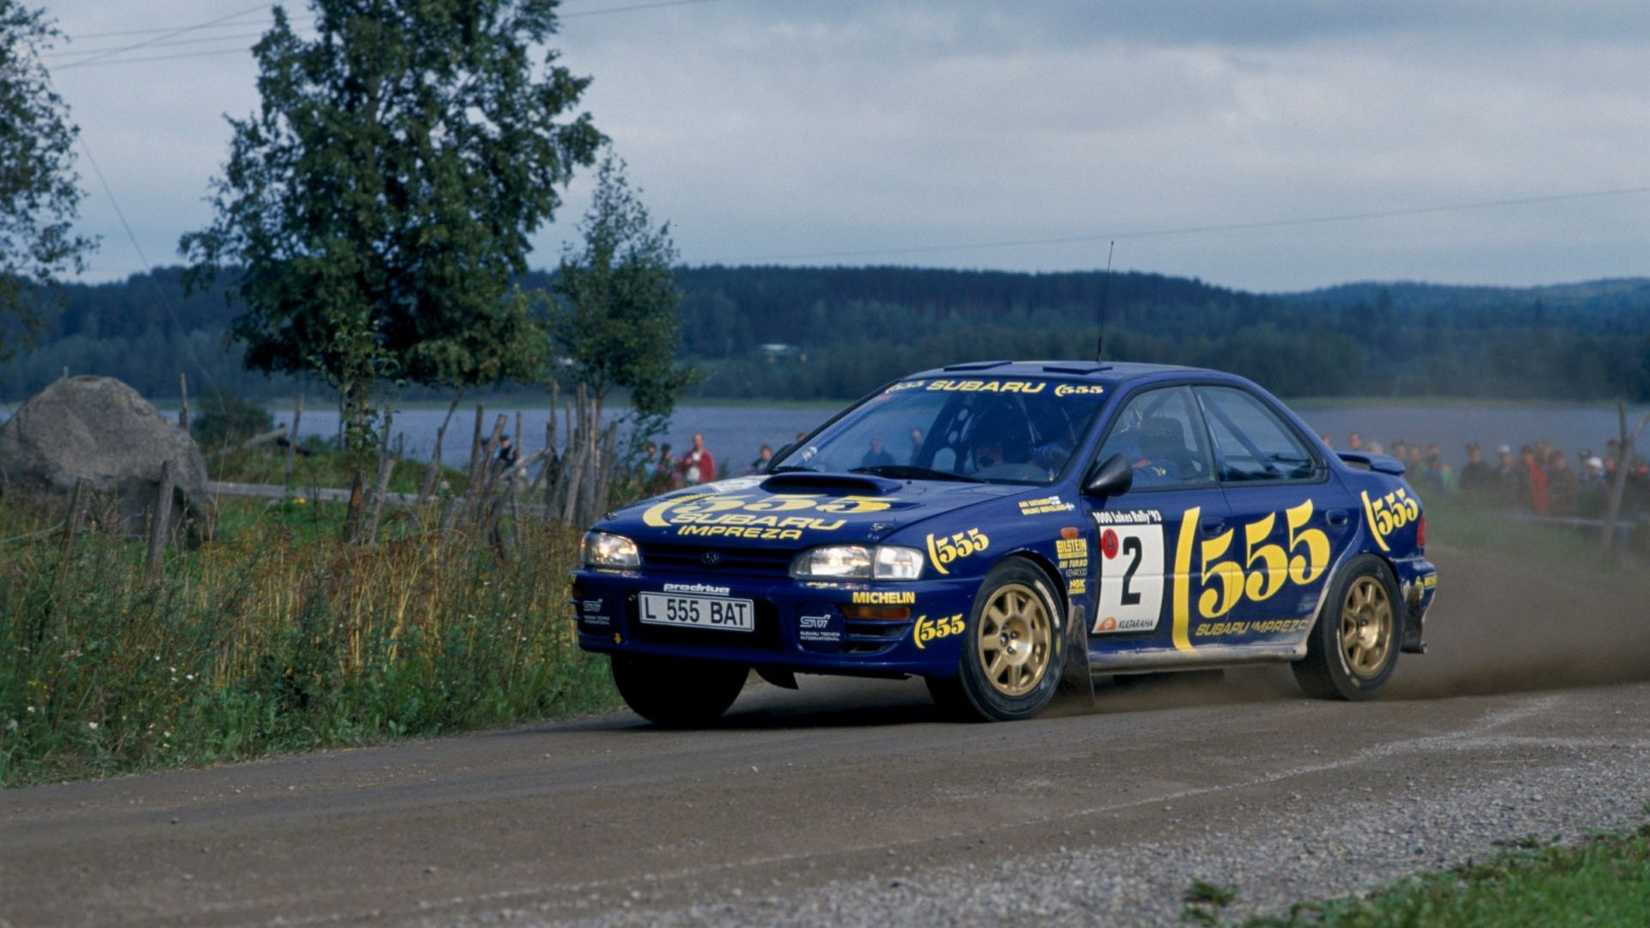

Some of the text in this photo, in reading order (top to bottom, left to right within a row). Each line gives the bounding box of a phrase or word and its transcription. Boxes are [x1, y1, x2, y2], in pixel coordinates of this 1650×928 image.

[926, 380, 1046, 393] SUBARU
[1061, 385, 1103, 394] 555
[670, 513, 847, 530] SUBARU
[1373, 488, 1418, 535] 555
[677, 525, 803, 540] IMPREZA
[936, 528, 989, 563] 555
[1121, 536, 1142, 605] 2
[1198, 499, 1330, 618] 555
[645, 597, 747, 626] L 555 BAT
[853, 592, 915, 604] MICHELIN
[921, 613, 966, 641] 555
[1195, 622, 1250, 636] SUBARU
